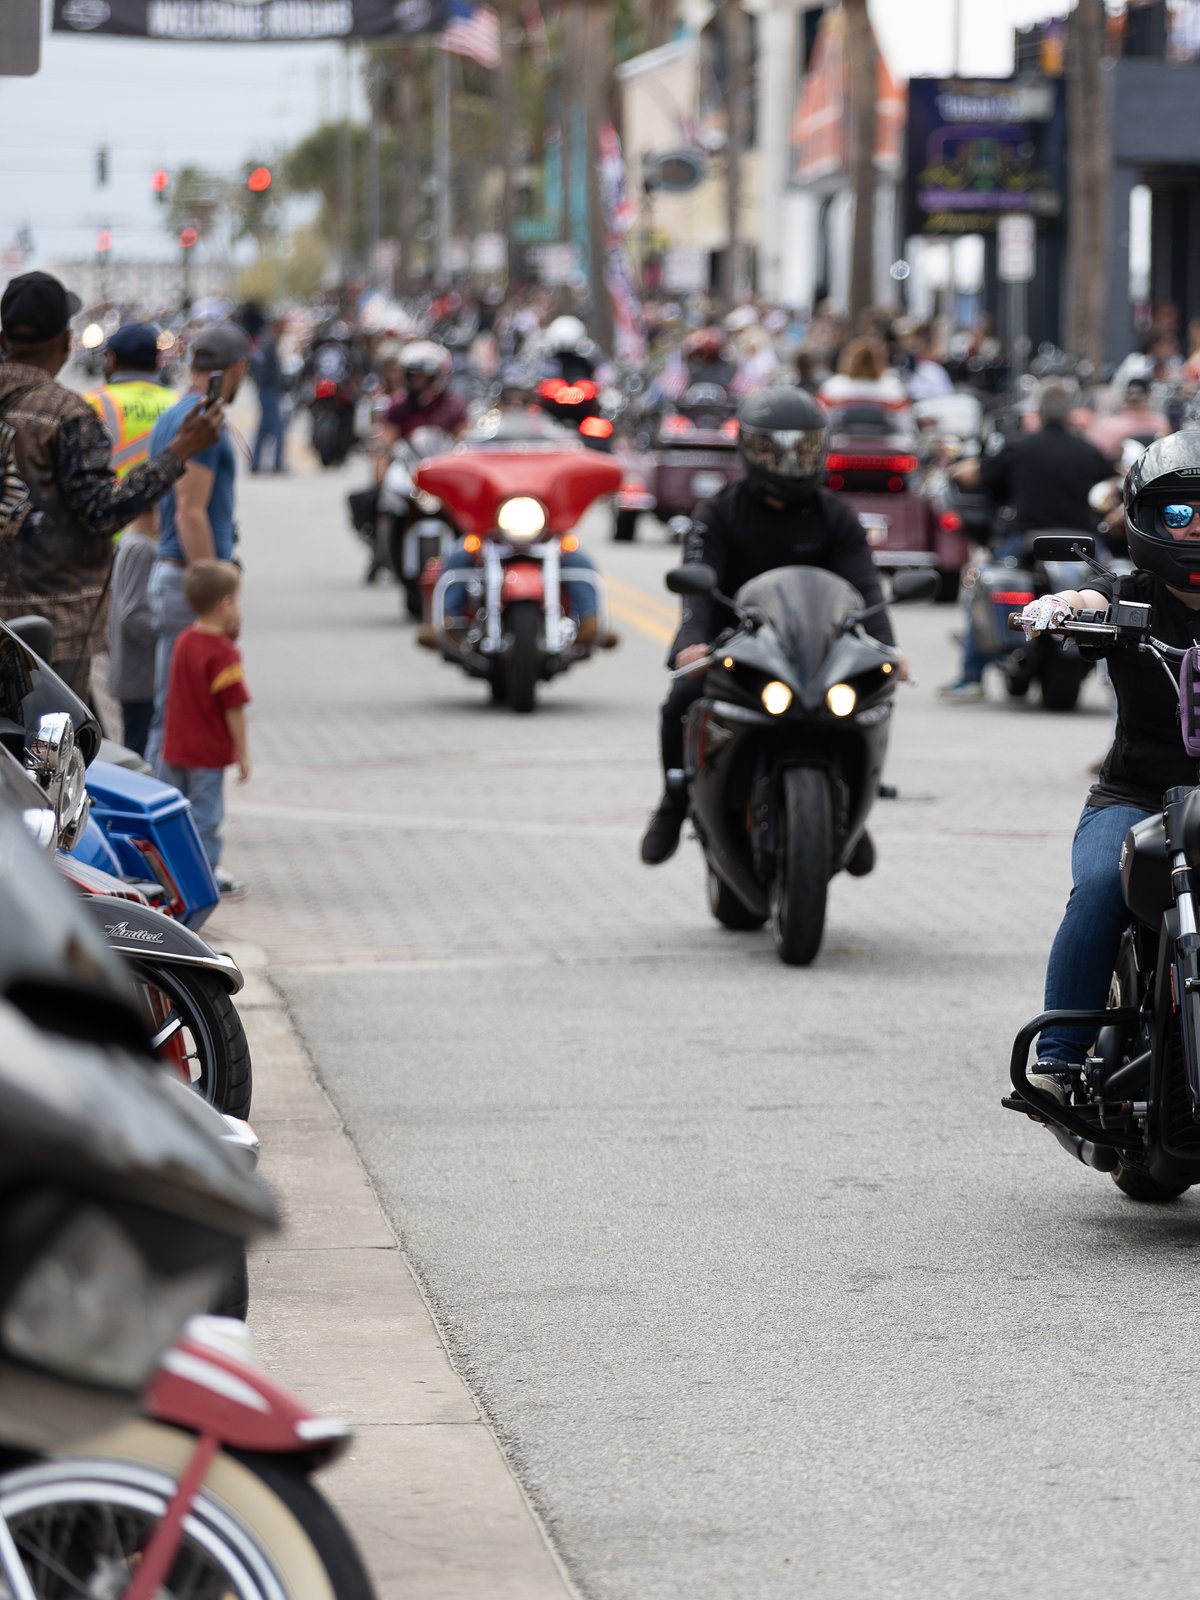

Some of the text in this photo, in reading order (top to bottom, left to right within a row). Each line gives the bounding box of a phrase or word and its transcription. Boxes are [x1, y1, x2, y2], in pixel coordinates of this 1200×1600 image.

[146, 0, 266, 39] WELCOME
[270, 0, 353, 37] RIDERS
[105, 921, 164, 944] Limited
